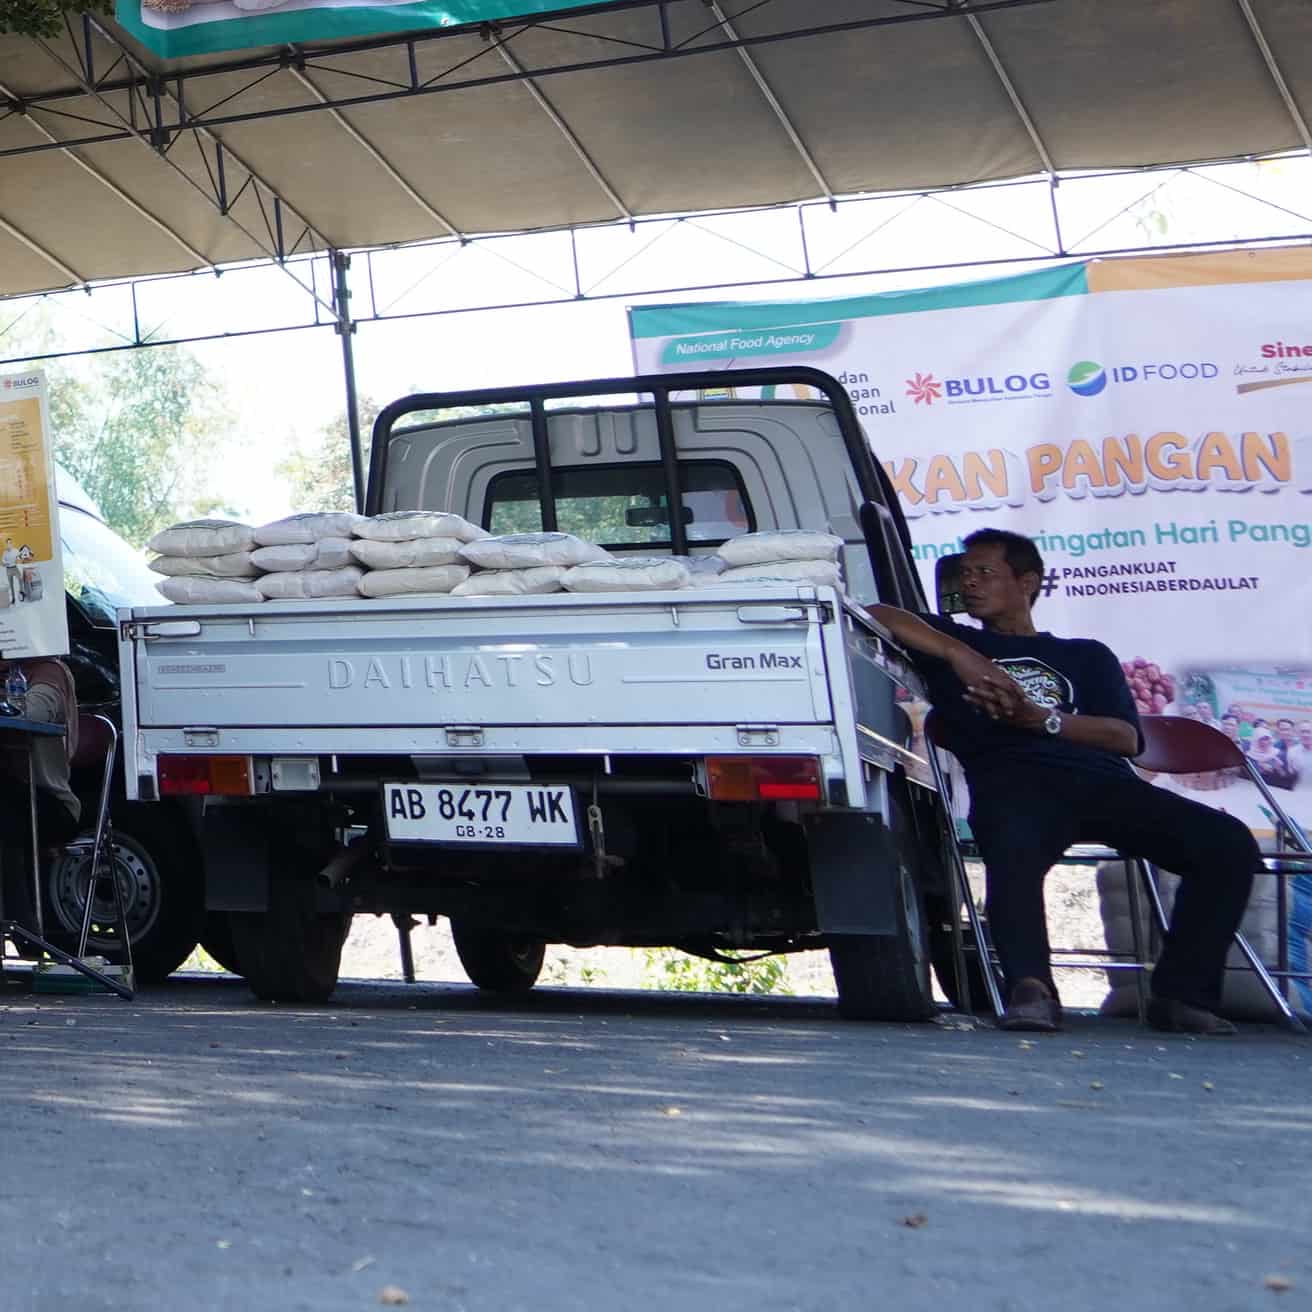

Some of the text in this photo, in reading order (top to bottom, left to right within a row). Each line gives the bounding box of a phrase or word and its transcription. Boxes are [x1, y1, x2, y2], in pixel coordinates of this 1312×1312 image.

[677, 333, 815, 355] National Food Agency
[838, 370, 869, 384] dan
[1113, 367, 1137, 383] ID
[1143, 363, 1218, 381] FOOD
[945, 373, 1051, 397] BULOG
[1027, 432, 1291, 494] PANGAN
[1154, 520, 1218, 545] Hari
[1063, 561, 1176, 579] PANGANKUAT
[1066, 577, 1259, 597] INDONESIABERDAULAT
[327, 655, 593, 689] DAIHATSU
[706, 652, 802, 670] Gran Max
[391, 789, 569, 823] AB 8477 WK
